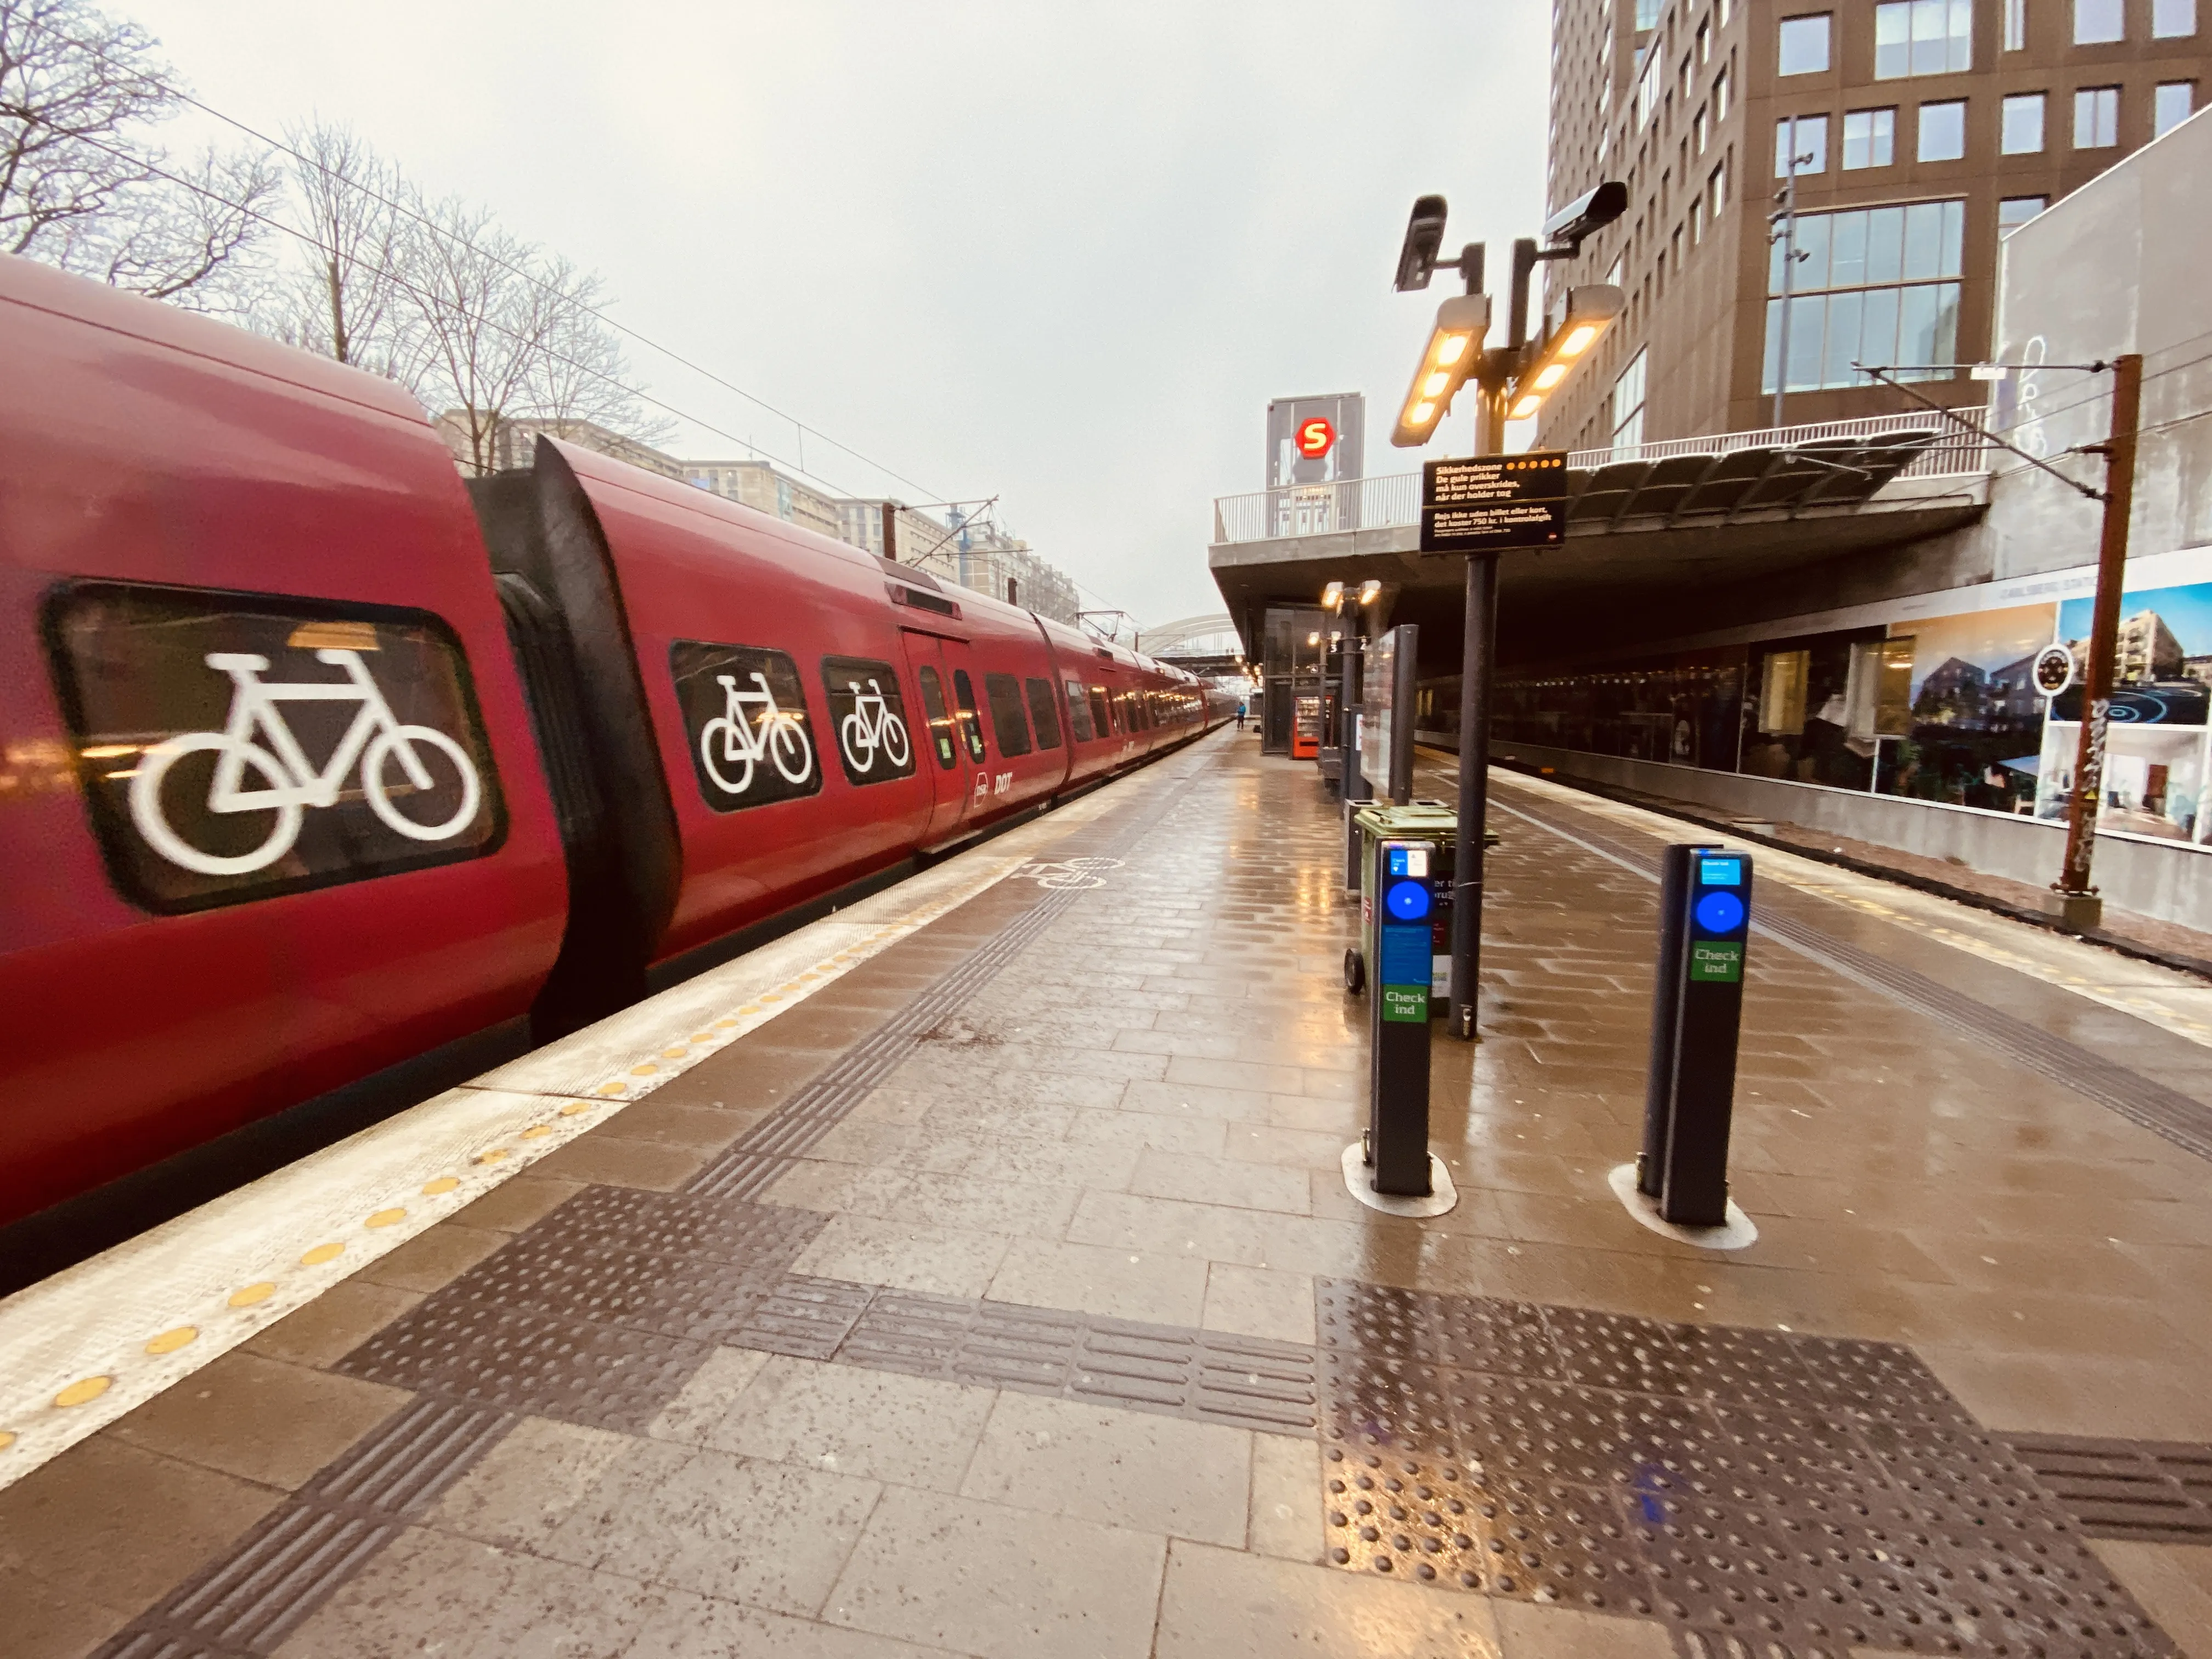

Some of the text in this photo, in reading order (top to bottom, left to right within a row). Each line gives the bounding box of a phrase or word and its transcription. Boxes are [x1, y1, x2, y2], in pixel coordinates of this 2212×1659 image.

[1304, 423, 1327, 449] S
[1436, 464, 1503, 475] Sikkerhedszone
[1450, 475, 1468, 483] gule
[1470, 472, 1500, 482] prikker
[1436, 484, 1449, 492] må
[1469, 480, 1520, 490] overskrides,
[1467, 490, 1495, 499] holder
[994, 771, 1013, 795] DOT
[1695, 949, 1739, 961] Check
[1705, 963, 1726, 973] ind
[1386, 991, 1425, 1003] Check
[1395, 1004, 1415, 1014] ind
